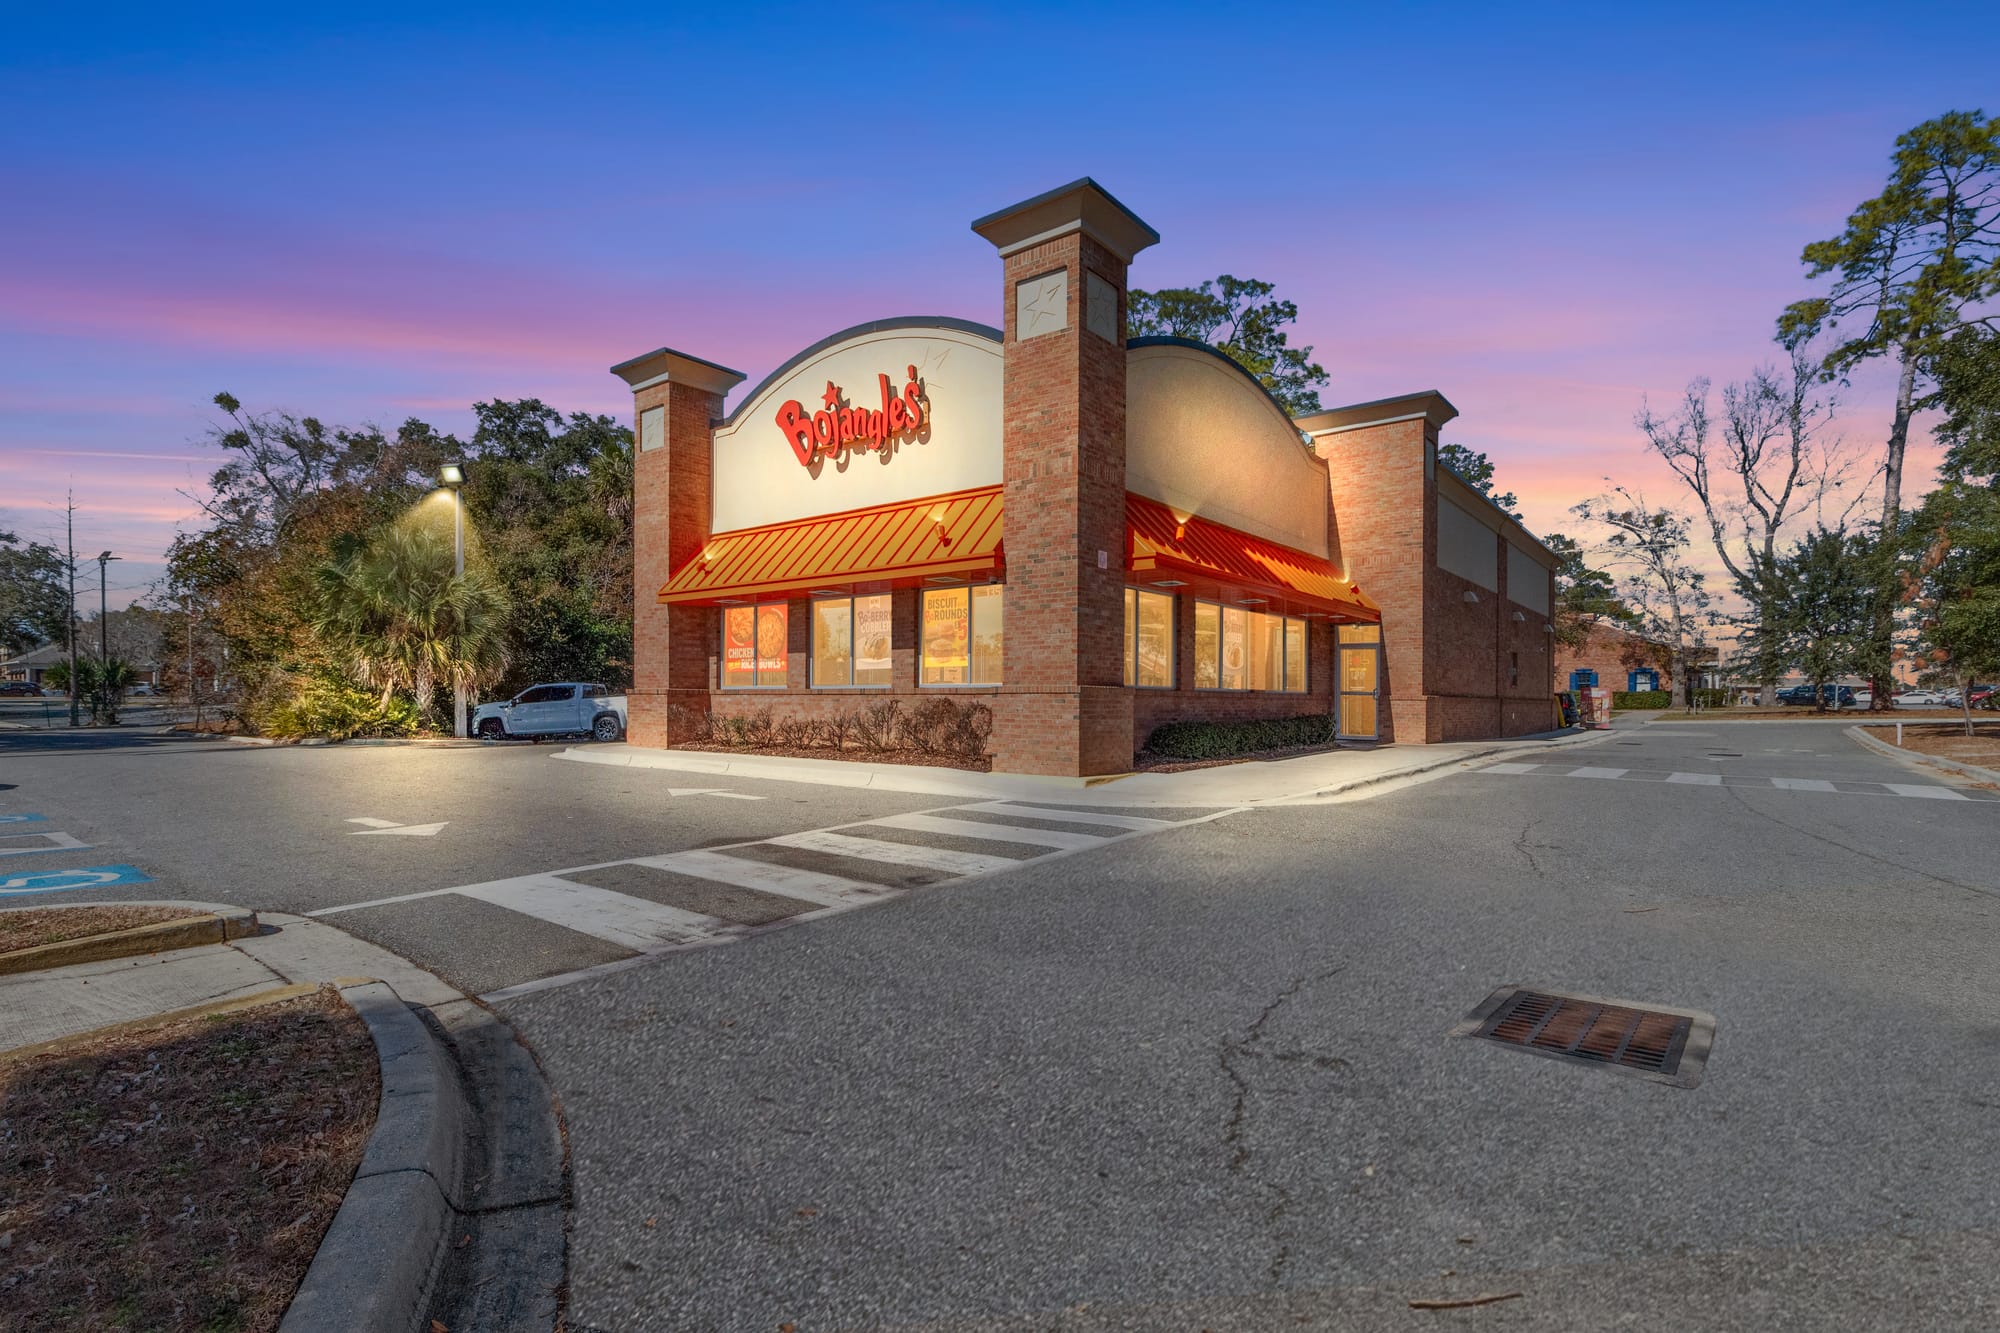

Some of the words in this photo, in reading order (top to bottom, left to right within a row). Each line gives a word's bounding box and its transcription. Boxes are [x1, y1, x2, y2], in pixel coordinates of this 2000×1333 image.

[928, 597, 958, 610] BISCUIT
[728, 647, 755, 659] CHICKEN
[758, 657, 781, 669] BOWLS
